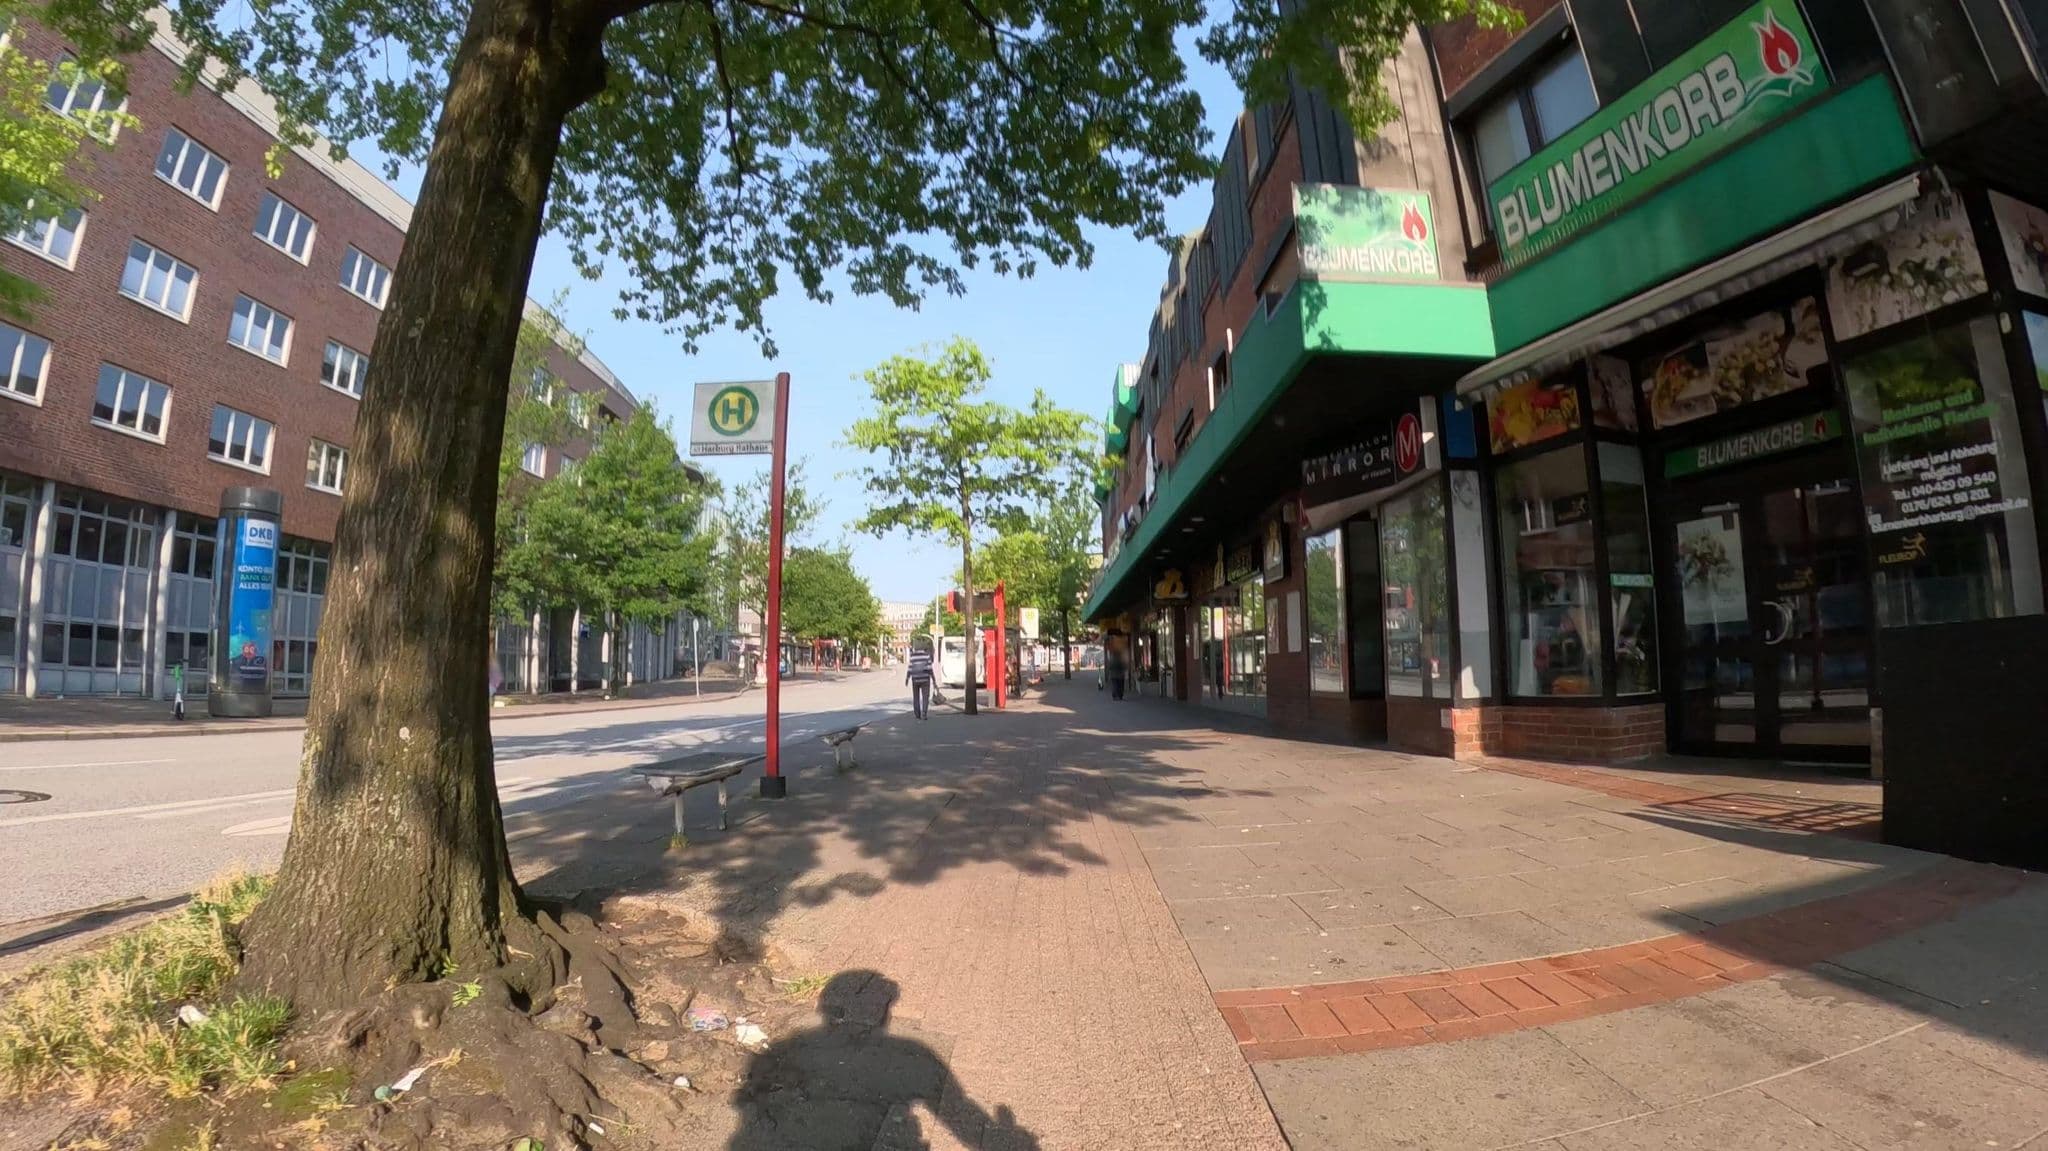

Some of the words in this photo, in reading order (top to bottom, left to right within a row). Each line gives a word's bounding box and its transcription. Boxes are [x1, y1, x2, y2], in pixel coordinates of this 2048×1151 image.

[1498, 54, 1746, 247] BLUMENKORB
[1304, 244, 1436, 274] BLUMENKORB
[722, 397, 746, 424] H
[1697, 421, 1804, 468] BLUMENKORB
[1883, 456, 1930, 475] Lieferung
[1950, 442, 1997, 461] Abholung
[1306, 447, 1390, 486] MIRROR
[1911, 479, 1956, 498] 040-429
[1974, 471, 1996, 485] 540
[249, 527, 272, 540] DKB
